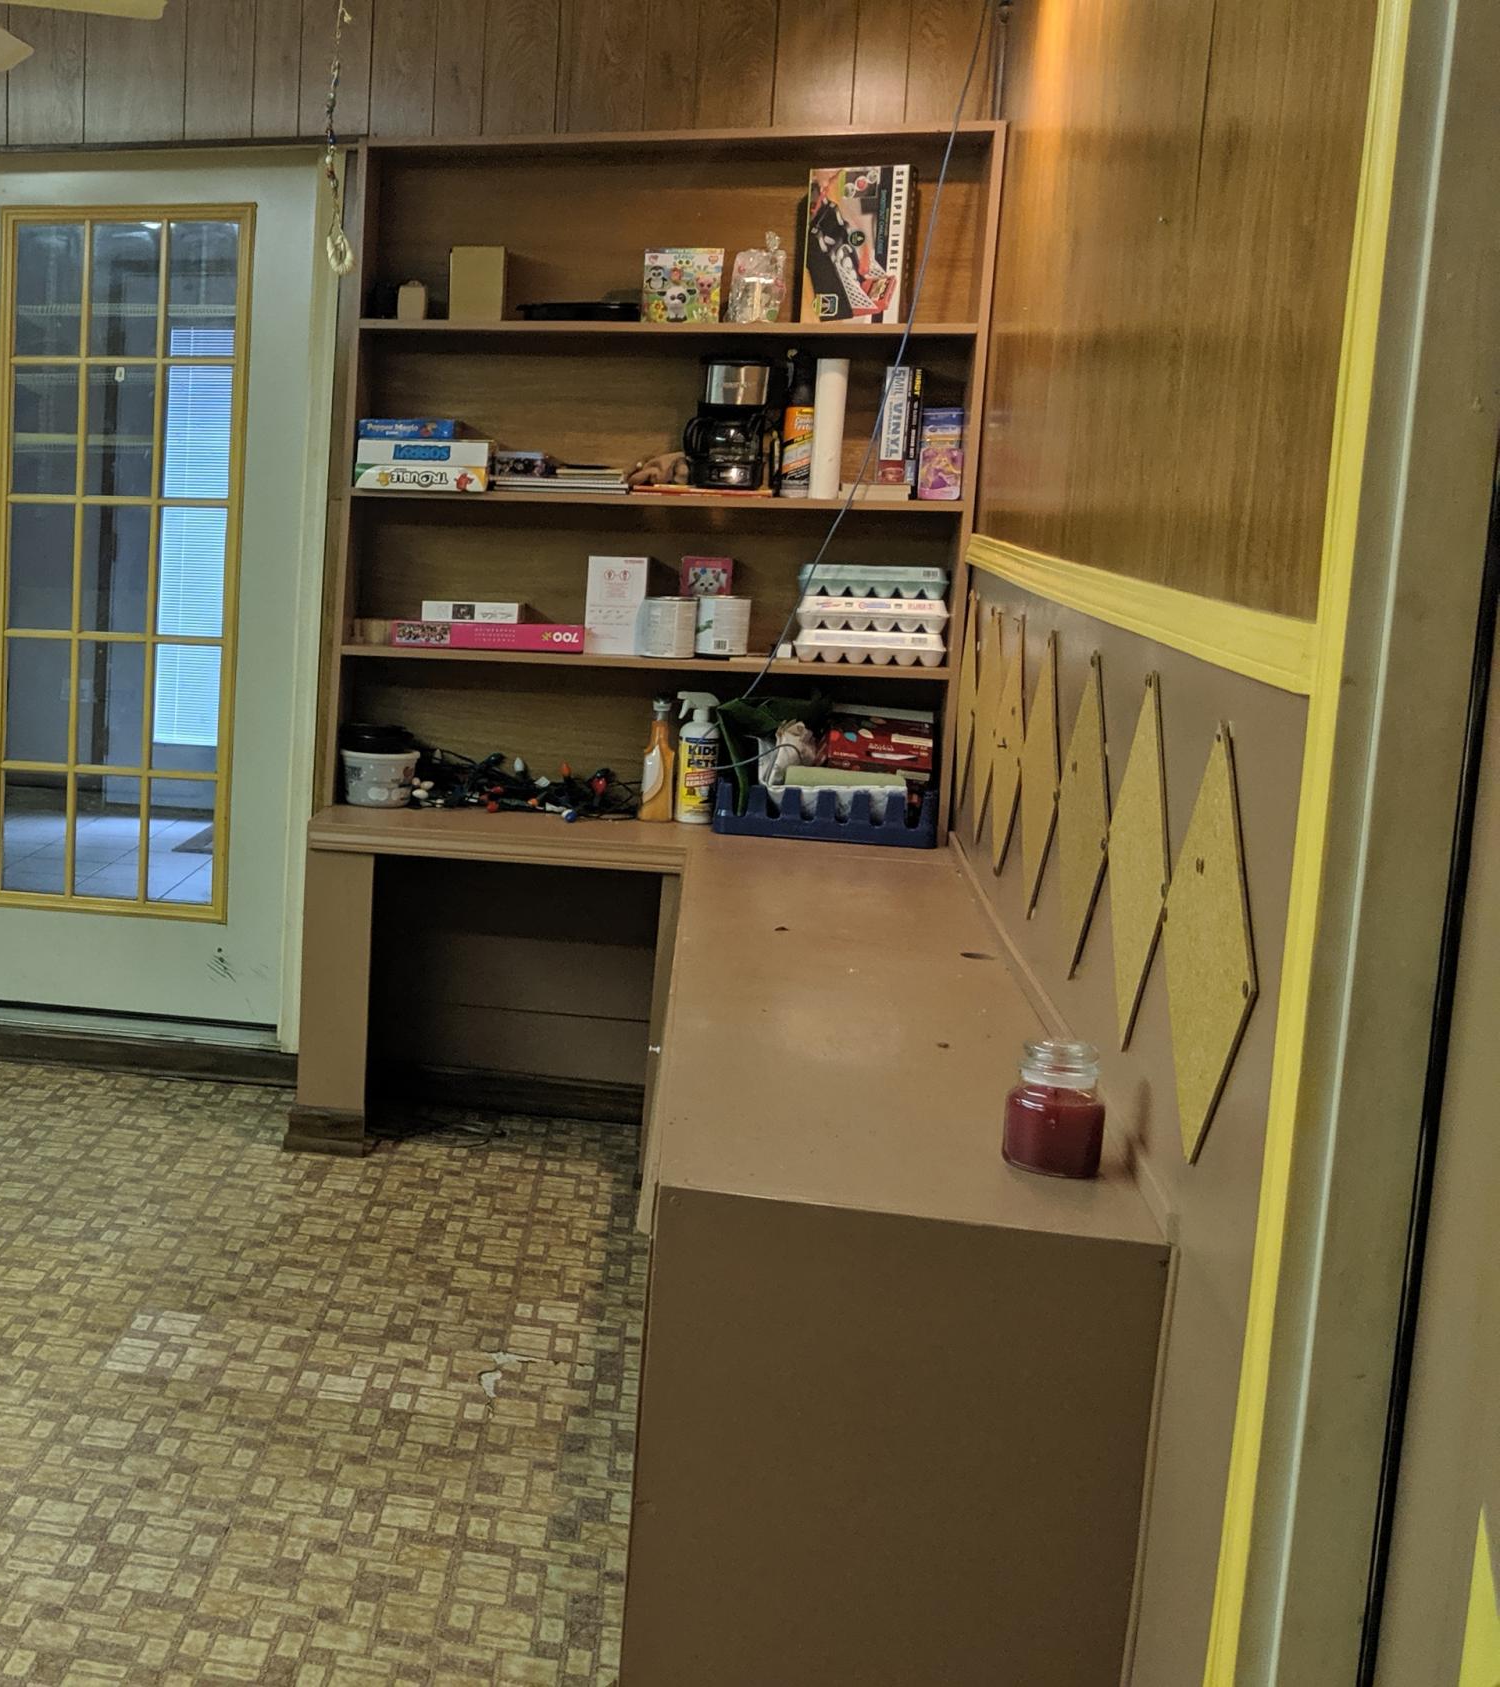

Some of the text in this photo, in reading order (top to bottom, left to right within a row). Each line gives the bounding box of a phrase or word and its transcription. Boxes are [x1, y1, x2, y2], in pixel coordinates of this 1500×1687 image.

[889, 170, 904, 271] SHARPER IMAGE
[914, 368, 923, 396] HARDY
[889, 401, 904, 457] VINYL
[390, 471, 448, 487] TROUBLE
[552, 632, 579, 643] 700
[688, 745, 716, 756] KIDS
[687, 758, 716, 769] PETS
